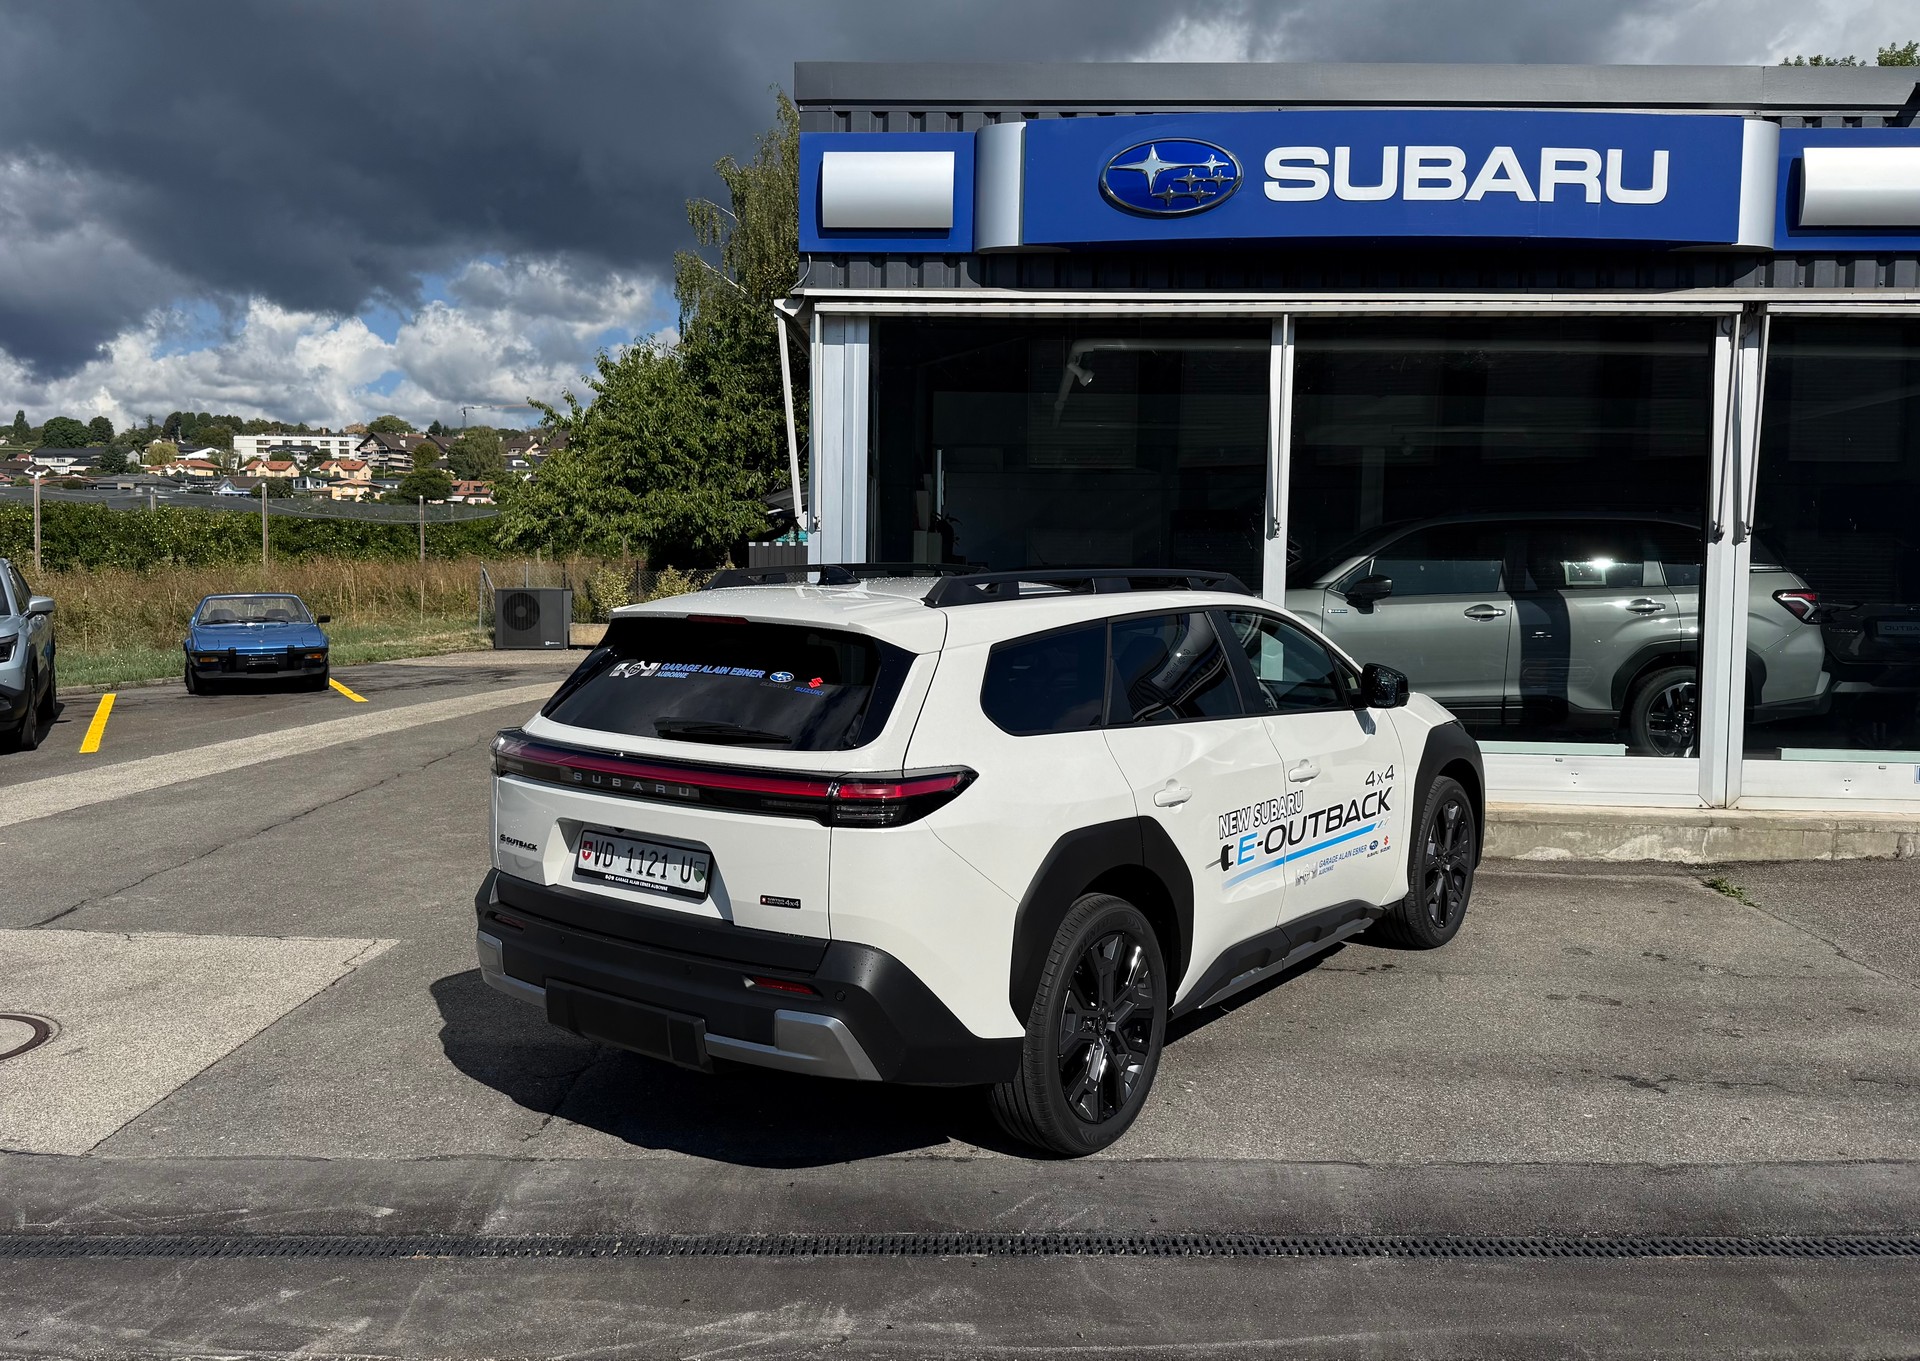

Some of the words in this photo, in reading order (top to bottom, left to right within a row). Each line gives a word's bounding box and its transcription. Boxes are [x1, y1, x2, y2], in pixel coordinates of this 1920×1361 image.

[1264, 146, 1669, 204] SUBARU
[661, 662, 701, 672] GARAGE
[699, 665, 731, 675] ALAIN
[728, 667, 765, 678] EBNER
[794, 687, 825, 695] SUZUKI
[573, 771, 690, 797] SUBARU
[1218, 806, 1251, 840] NEW
[1253, 790, 1304, 828] SUBARU
[1237, 786, 1393, 866] E-OUTBACK
[594, 839, 615, 868] VD
[625, 847, 668, 879] 1121
[680, 856, 693, 883] U
[1319, 854, 1338, 868] GARAGE
[1339, 849, 1353, 861] ALAIN
